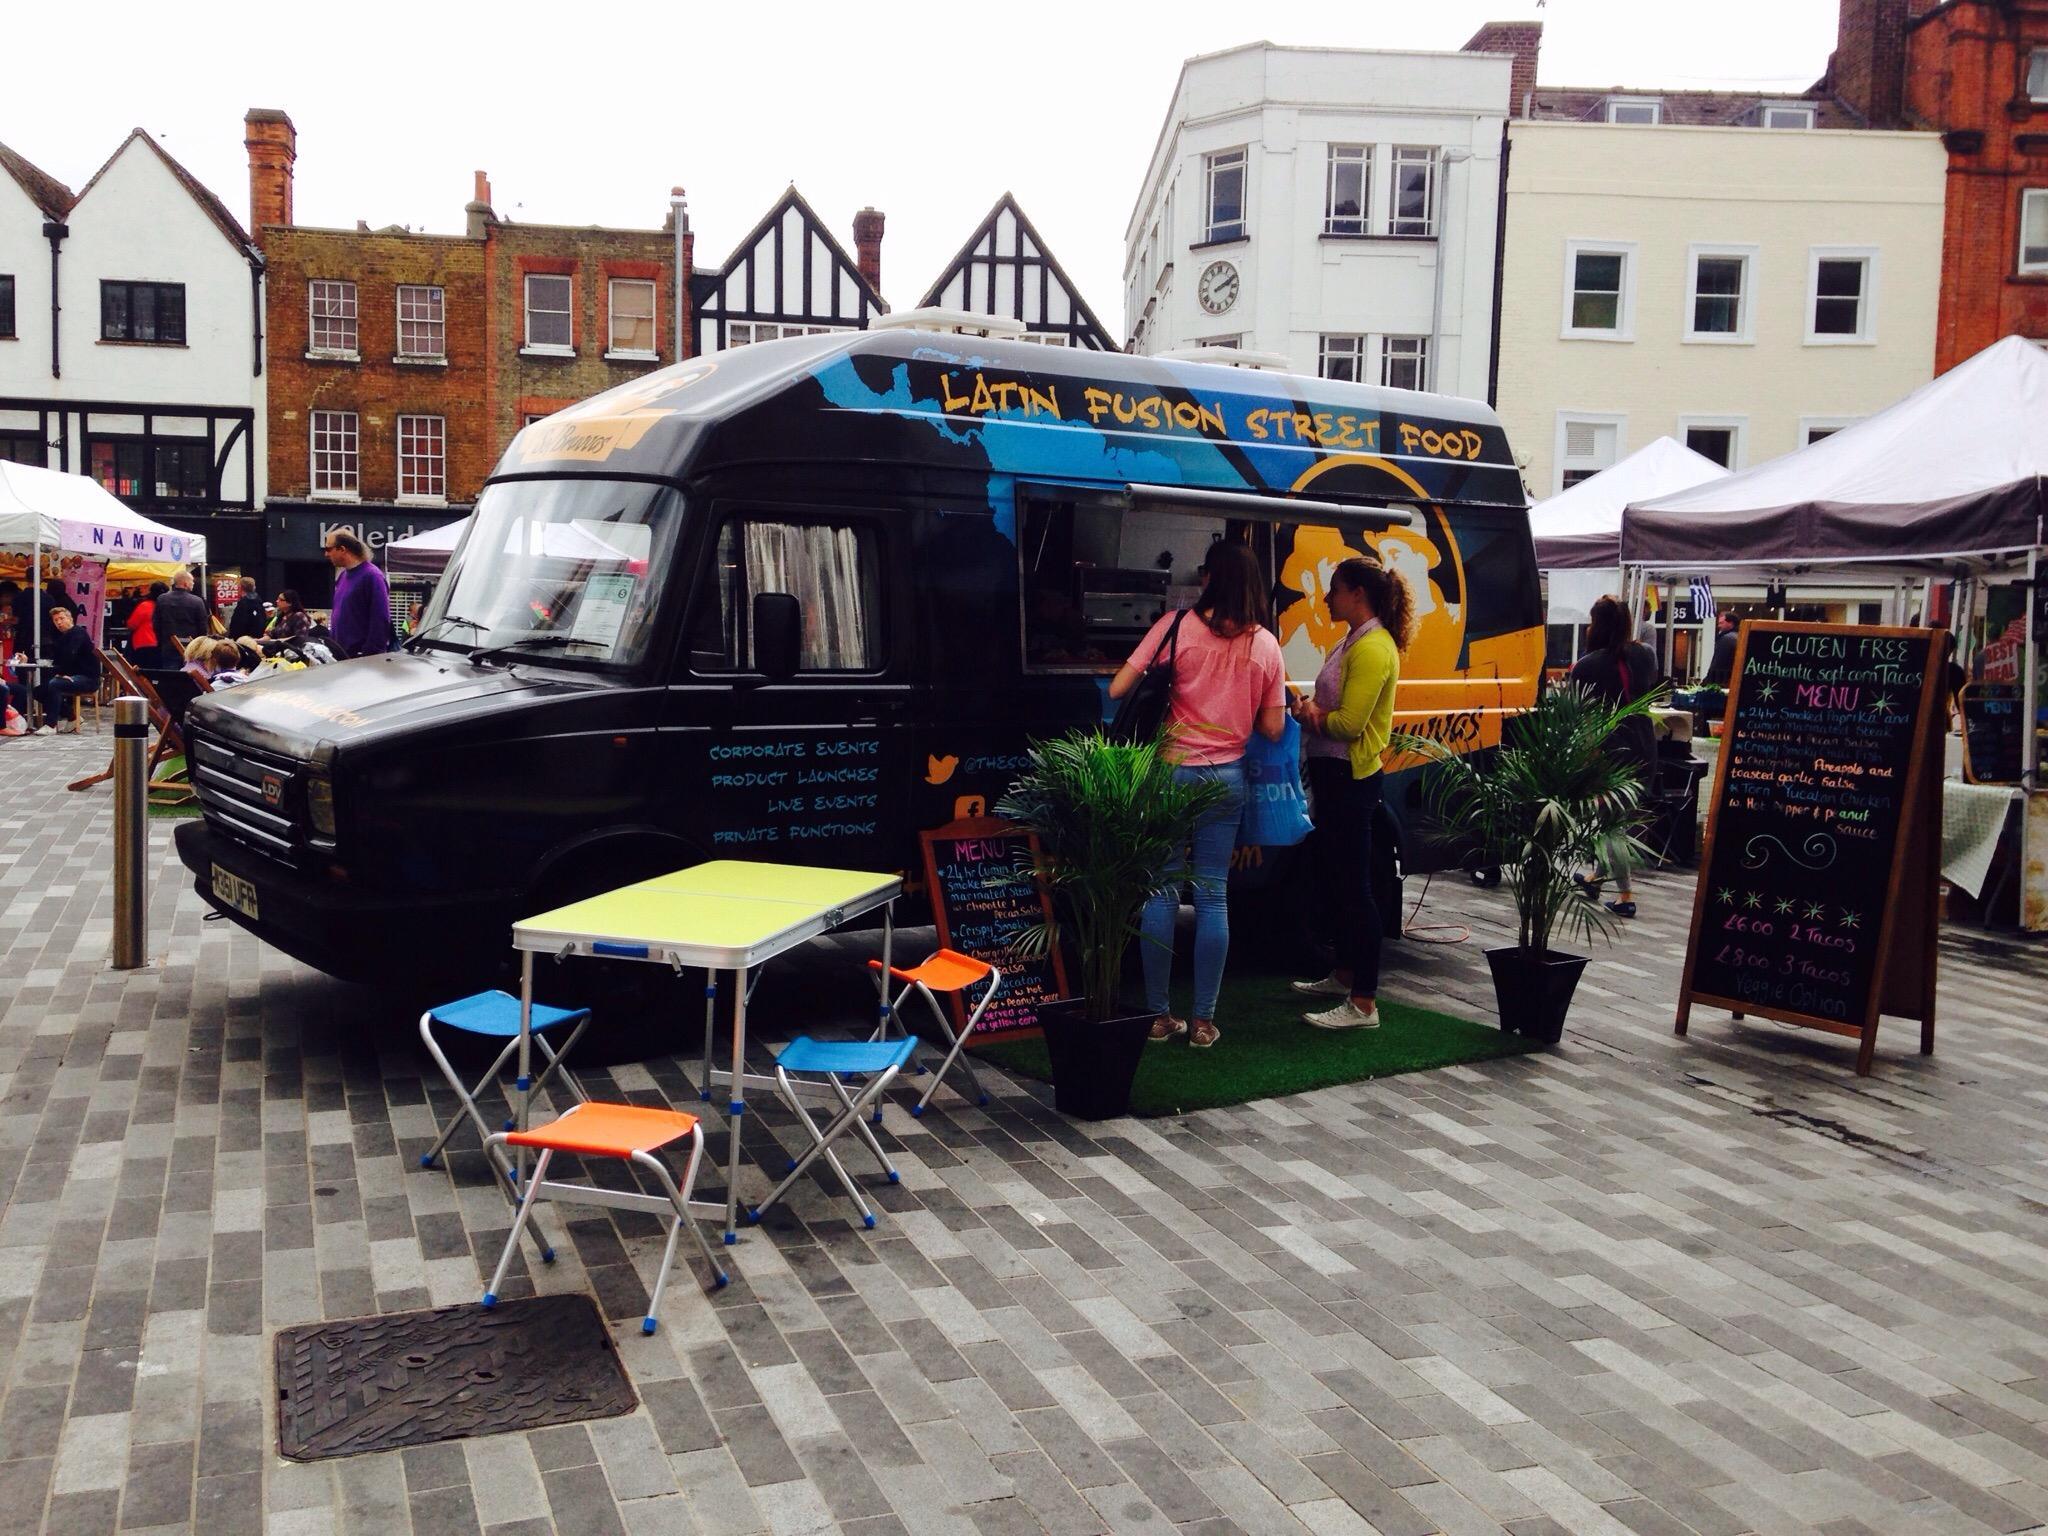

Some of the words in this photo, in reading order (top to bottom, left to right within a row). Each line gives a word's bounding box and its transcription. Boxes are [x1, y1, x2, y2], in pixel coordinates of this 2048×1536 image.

[940, 372, 1062, 421] LATIN
[1084, 386, 1227, 435] FUSION
[1246, 408, 1380, 449] STREET
[1399, 422, 1483, 461] FOOD
[93, 527, 163, 552] NAMU
[217, 580, 239, 591] 25%
[217, 590, 239, 599] OFF
[1770, 635, 1846, 660] GLUTEN
[1859, 638, 1909, 662] FREE
[1985, 640, 2013, 662] BEST
[1744, 656, 1812, 682] Authentic
[1817, 664, 1844, 683] soft
[1848, 667, 1877, 683] corn
[1875, 663, 1922, 688] Tacos
[1795, 683, 1860, 711] MENU
[1984, 701, 2012, 714] MENU
[1780, 707, 1823, 722] Smoked
[1885, 713, 1911, 724] and
[709, 741, 807, 761] CORPORATE
[815, 740, 880, 756] EVENTS
[712, 770, 788, 788] PRODUCT
[797, 767, 880, 785] LAUNCHES
[1730, 767, 1774, 782] toasted
[1777, 769, 1815, 787] garlic
[1812, 757, 1864, 776] Pineapple
[1869, 766, 1894, 778] and
[262, 781, 282, 800] LDV
[1741, 782, 1771, 796] Torn
[1783, 783, 1836, 804] Yucatan
[767, 796, 804, 814] LIVE
[814, 793, 878, 811] EVENTS
[712, 825, 779, 844] PRIVATE
[788, 821, 877, 841] FUNCTIONS
[1834, 823, 1880, 841] sauce
[954, 839, 1006, 862] MENU
[946, 864, 963, 881] 24
[959, 923, 994, 938] Crispy
[1786, 923, 1802, 941] 2
[1805, 926, 1856, 953] Tacos
[1778, 953, 1796, 976] 3
[1798, 959, 1850, 987] Tacos
[1735, 973, 1784, 1005] Veggie
[1789, 981, 1847, 1017] Option
[984, 1008, 1015, 1020] served
[1018, 1007, 1030, 1016] on
[989, 1018, 1017, 1032] yellow
[1018, 1015, 1038, 1026] corn
